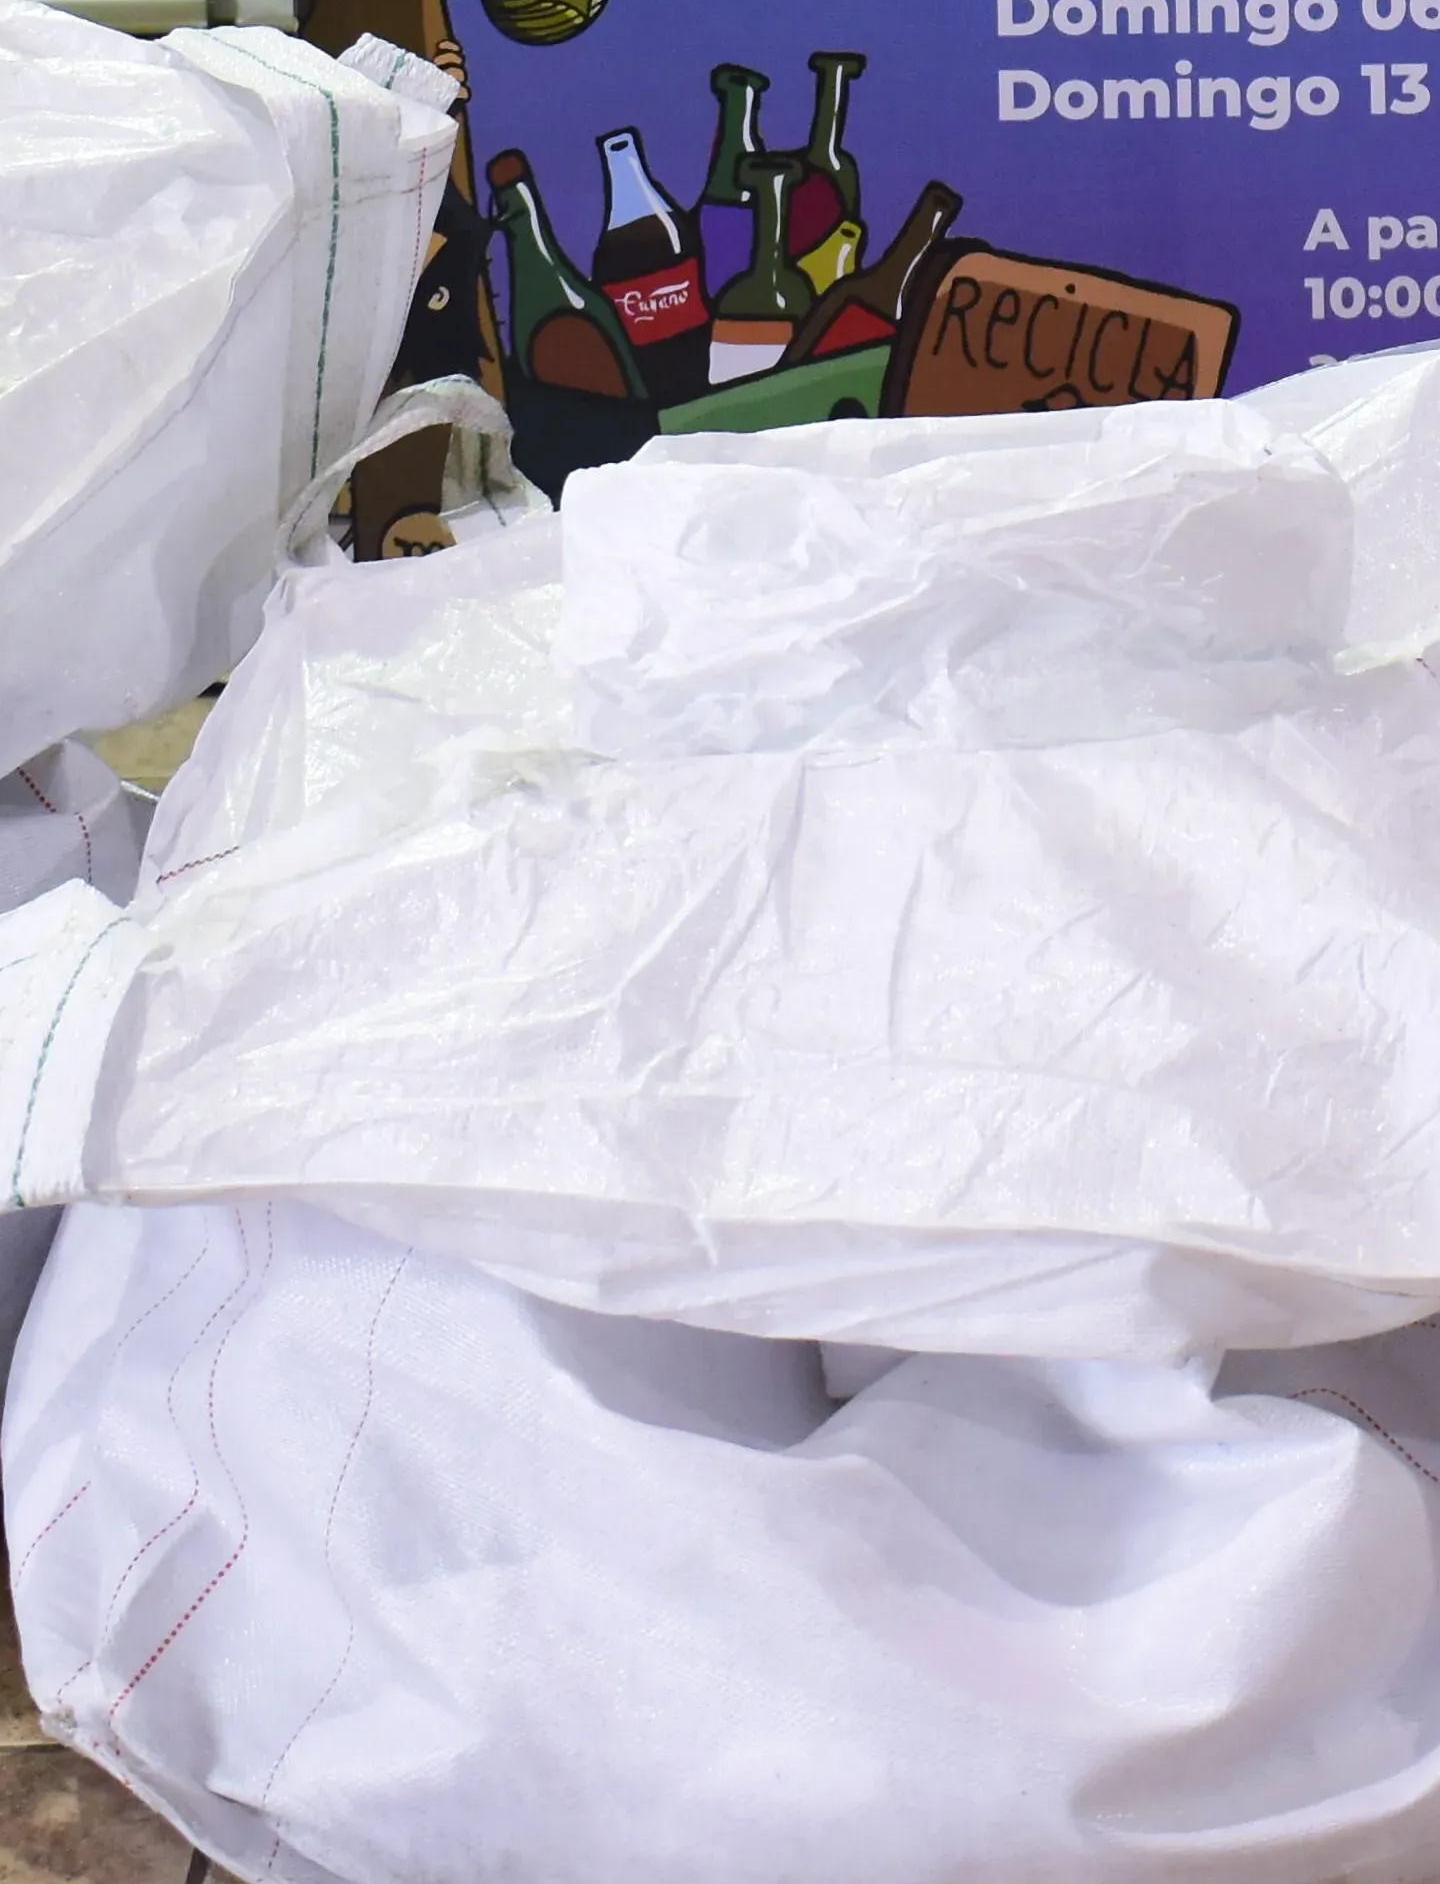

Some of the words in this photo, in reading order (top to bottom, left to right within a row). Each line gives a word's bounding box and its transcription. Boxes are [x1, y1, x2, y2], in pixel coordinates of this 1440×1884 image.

[997, 59, 1342, 130] Domingo
[1360, 65, 1433, 118] 13
[1303, 208, 1350, 250] A
